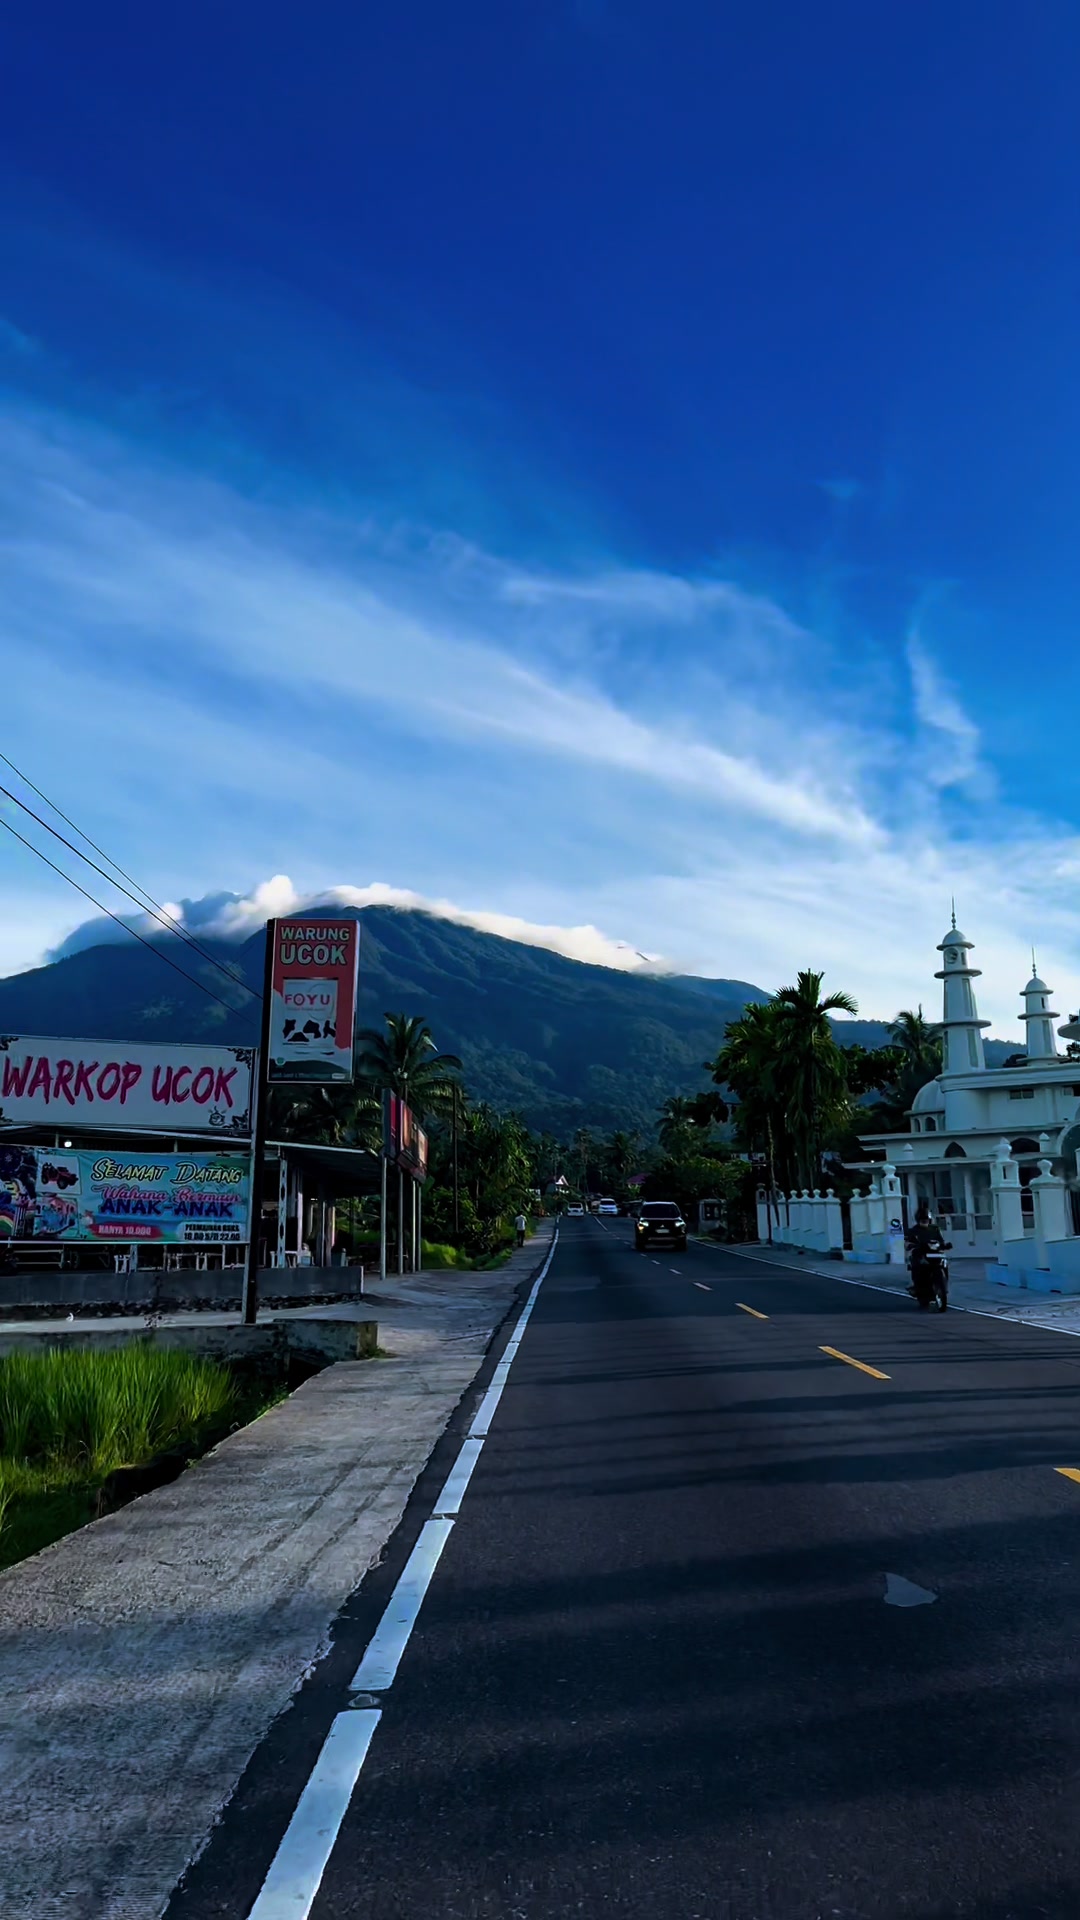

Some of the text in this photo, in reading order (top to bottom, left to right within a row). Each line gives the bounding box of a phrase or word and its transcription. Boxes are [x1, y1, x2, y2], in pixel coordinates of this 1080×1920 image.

[280, 926, 350, 941] WARUNG
[279, 943, 347, 965] UCOK
[284, 993, 330, 1006] FOYU
[1, 1055, 239, 1108] WARKOP UCOK
[91, 1157, 243, 1184] SELAMAT DATANG
[91, 1183, 167, 1201] Wahana
[100, 1198, 233, 1217] ANAK-ANAK
[98, 1225, 123, 1236] HANYA
